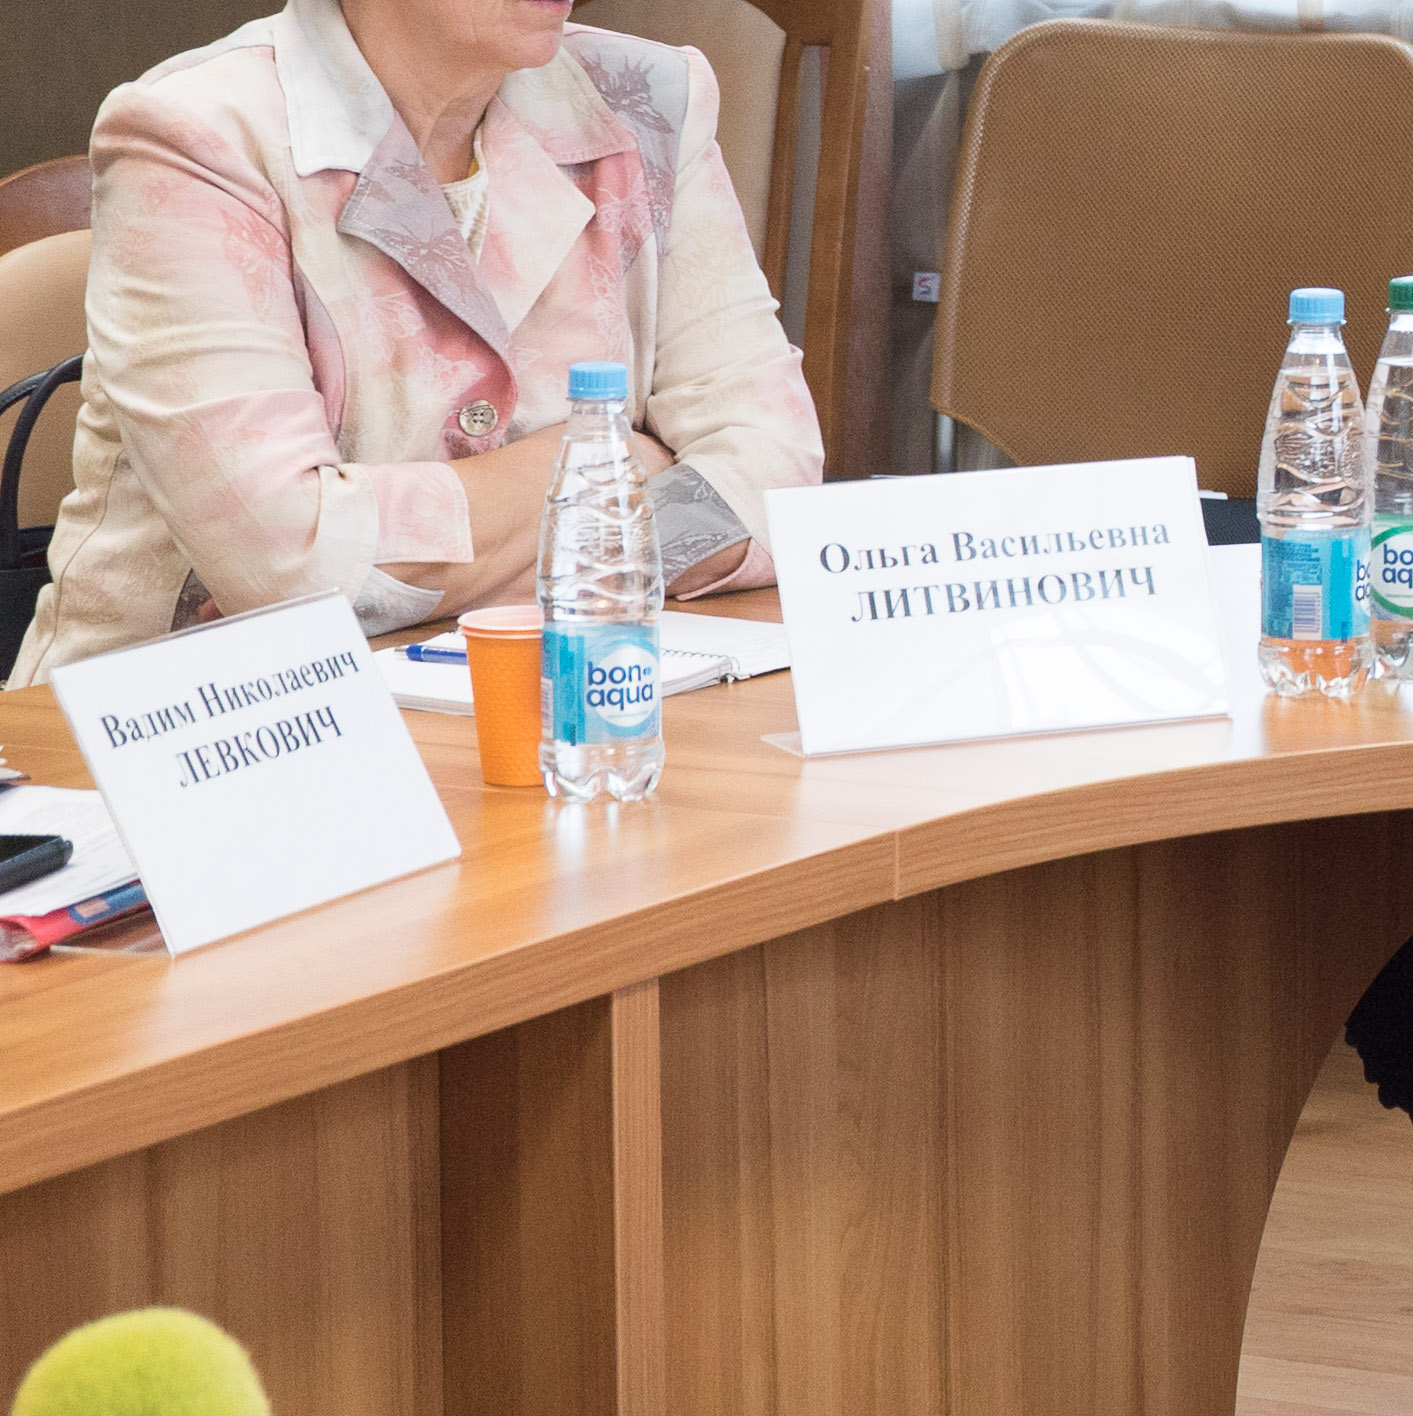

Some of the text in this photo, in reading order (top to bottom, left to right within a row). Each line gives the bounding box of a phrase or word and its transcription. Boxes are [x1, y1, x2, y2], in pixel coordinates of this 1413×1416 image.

[819, 523, 1171, 574] Ольга Васильевна
[851, 566, 1158, 622] ЛИТВИНОВИЧ
[586, 683, 653, 711] aqua
[587, 661, 641, 686] bon
[101, 652, 360, 749] Вадим Николаевич
[176, 706, 343, 787] ЛЕВКОВИЧ
